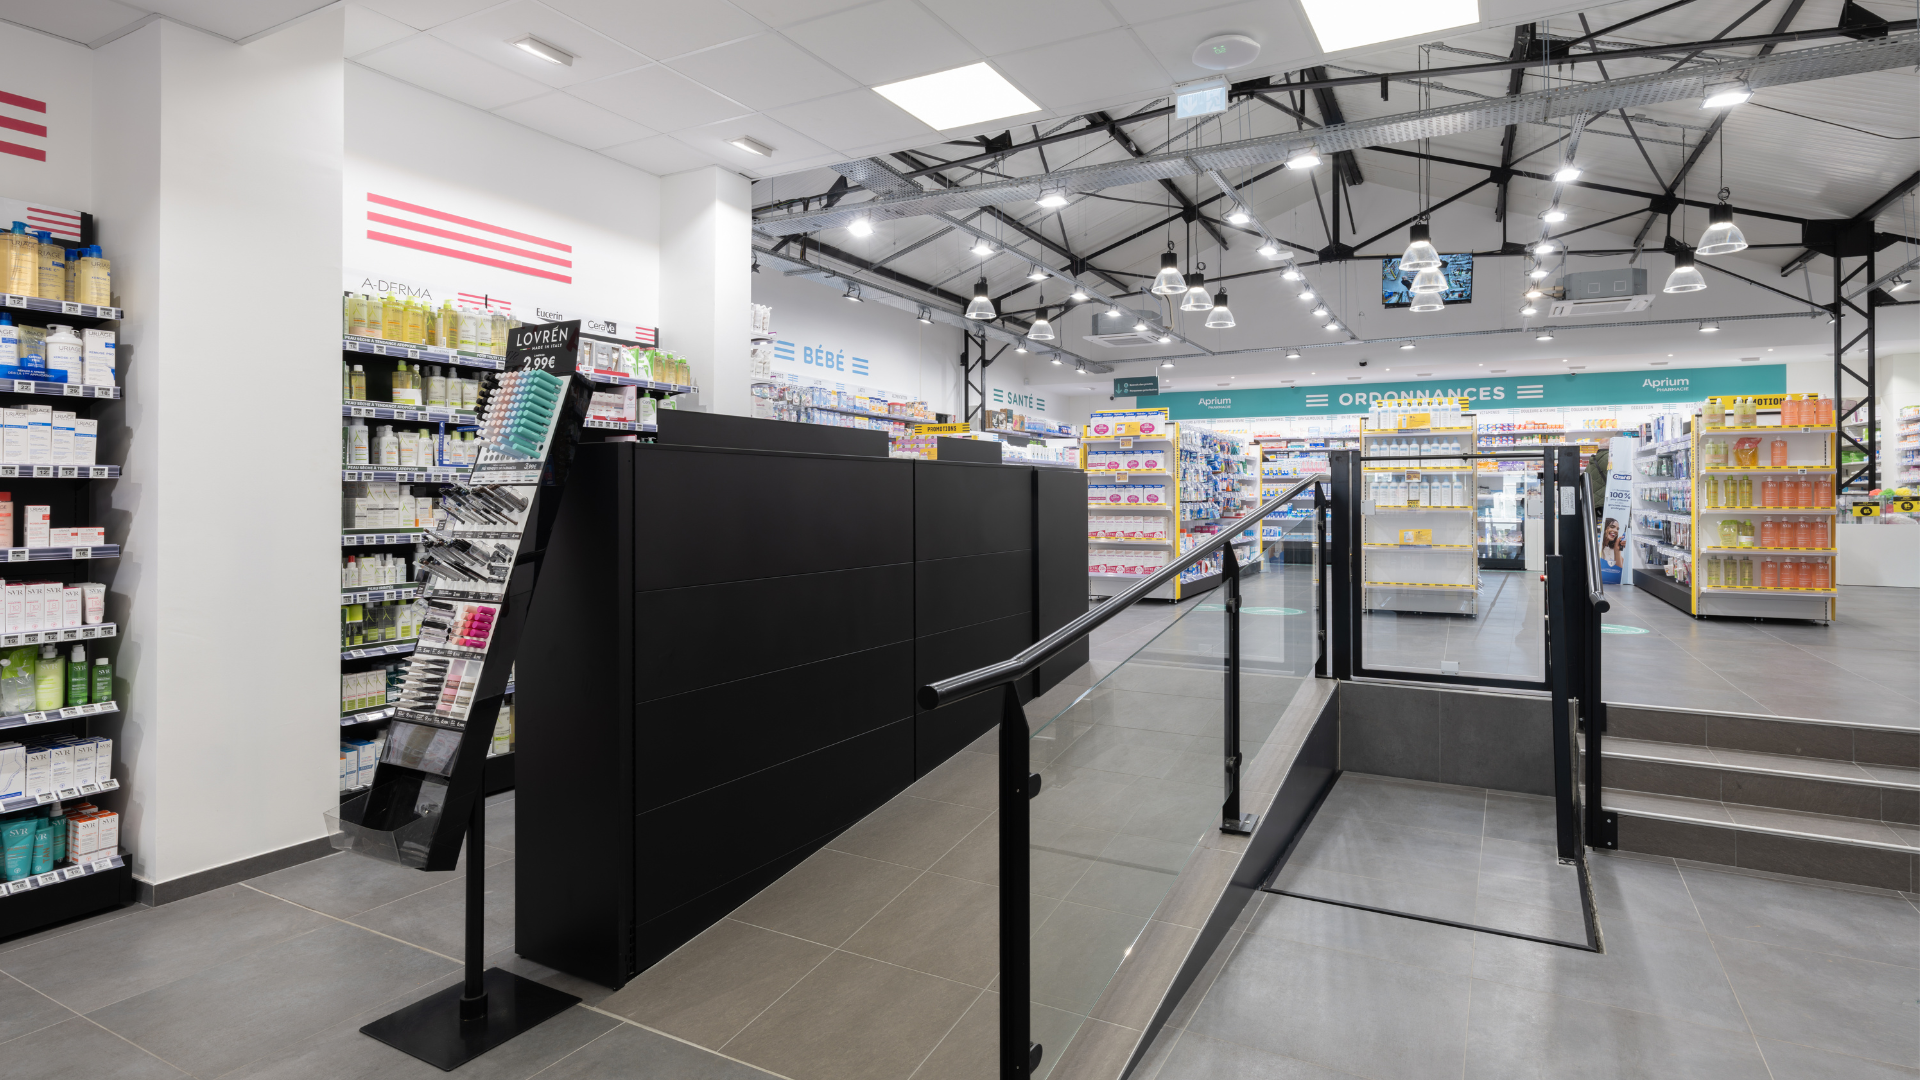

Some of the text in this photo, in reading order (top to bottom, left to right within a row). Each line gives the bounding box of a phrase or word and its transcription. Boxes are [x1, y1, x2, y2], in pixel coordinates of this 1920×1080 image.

[38, 250, 62, 258] RIAGE
[361, 278, 432, 301] A-DERMA
[536, 308, 563, 320] Eucerin
[588, 320, 615, 333] CeraVe
[516, 325, 569, 347] LOVRÉN
[803, 344, 845, 372] BÉBÉ
[1642, 377, 1689, 388] Aprium
[1338, 386, 1505, 406] ORDONNANCES
[1007, 393, 1033, 409] SANTÉ
[1198, 397, 1231, 407] Aprium
[1733, 398, 1785, 406] PMOTION
[927, 425, 957, 433] PROMOTIONS
[41, 663, 58, 671] SVR
[55, 749, 70, 757] SVR
[78, 746, 93, 754] SVR
[31, 753, 46, 761] SVR
[102, 817, 115, 825] SVR
[82, 822, 96, 830] SVR
[10, 828, 28, 836] SVR
